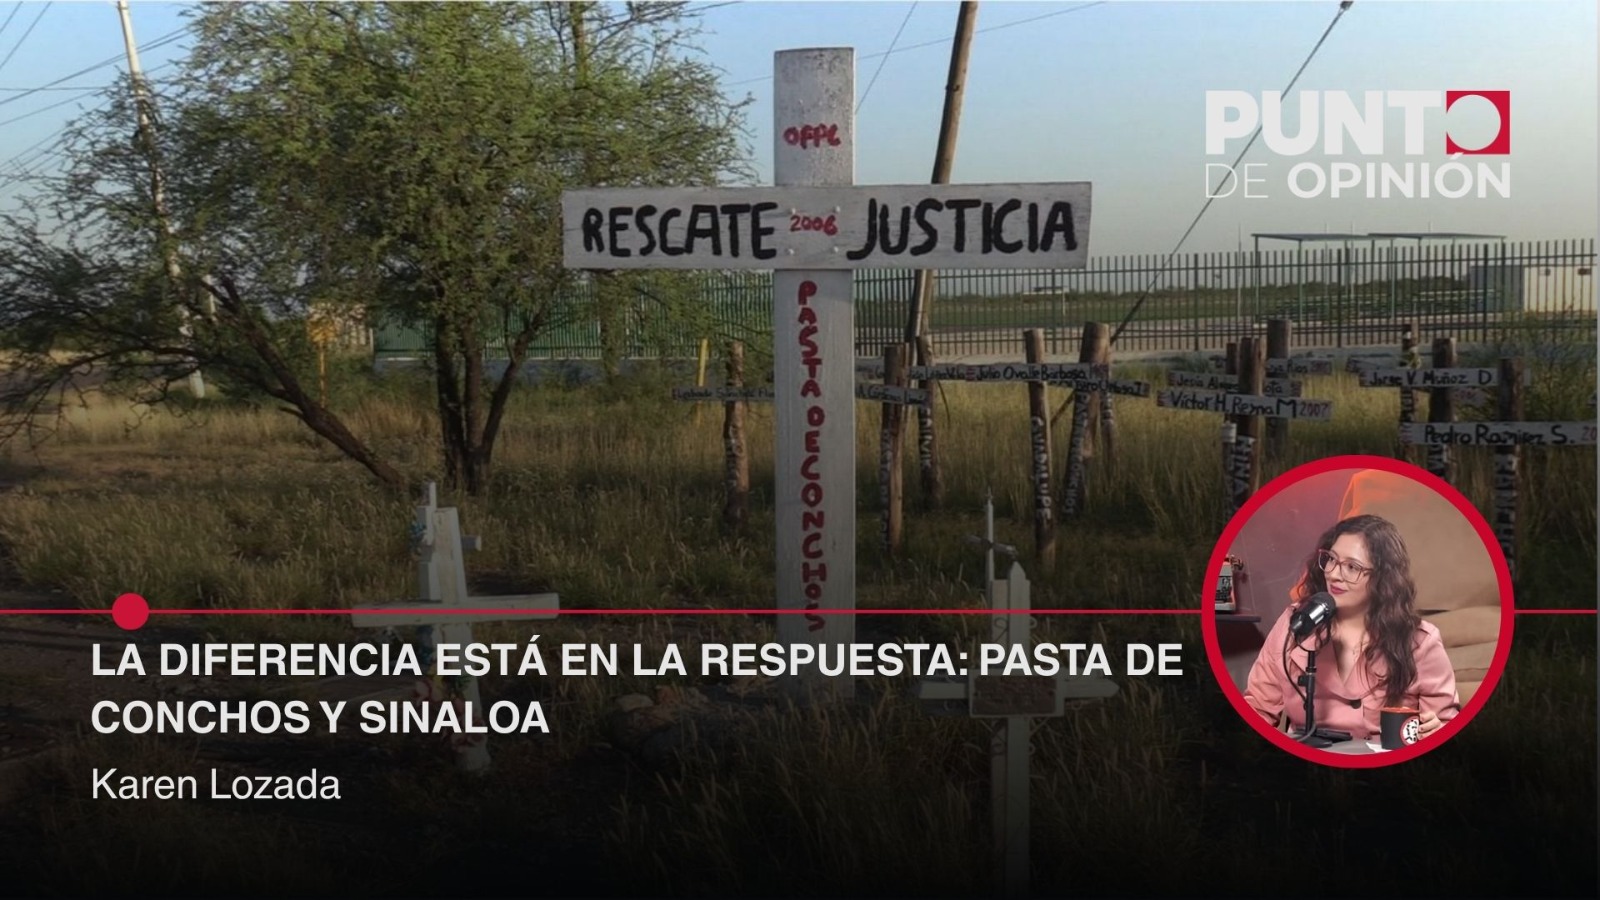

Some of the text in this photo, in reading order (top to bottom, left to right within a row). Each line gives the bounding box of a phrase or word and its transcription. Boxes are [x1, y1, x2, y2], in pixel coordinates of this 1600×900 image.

[582, 198, 1078, 260] RESCATE 2006 JUSTICIA
[798, 280, 823, 398] PASTA
[1275, 397, 1297, 419] M
[1424, 424, 1473, 445] Pedro
[800, 455, 827, 633] CONCHOS
